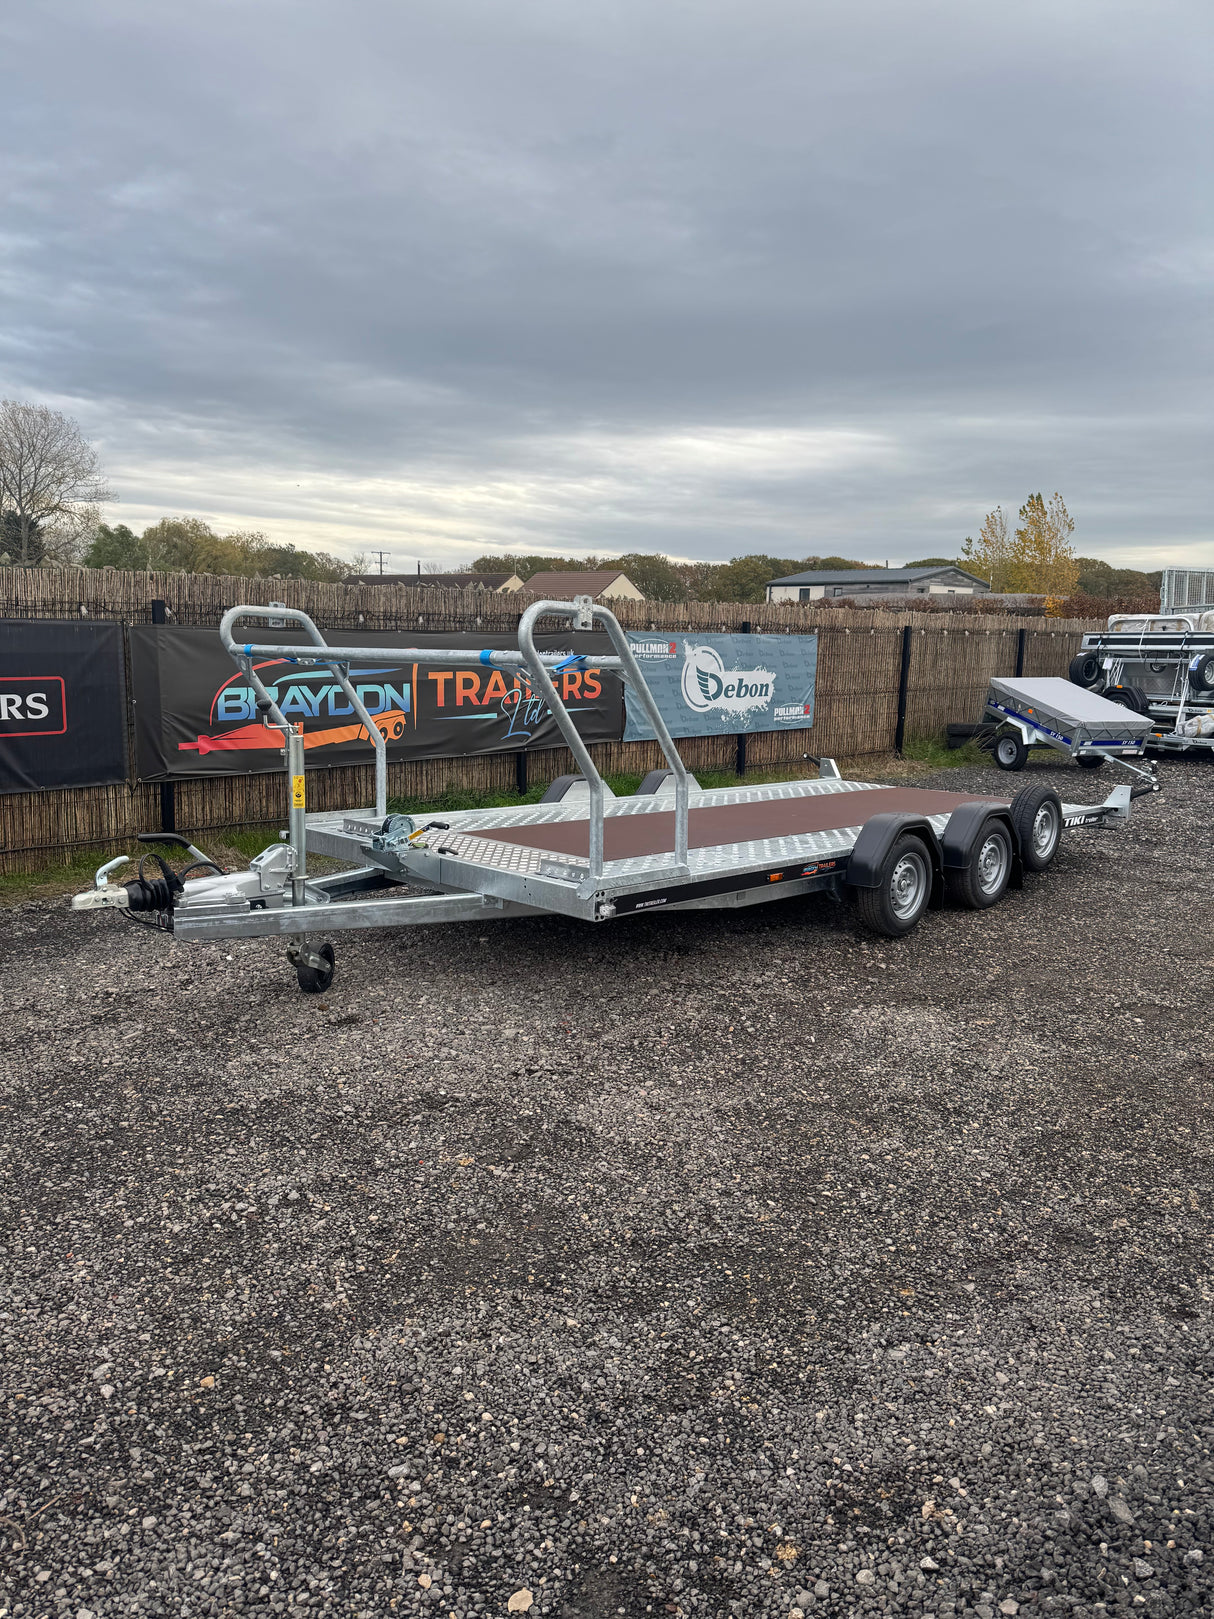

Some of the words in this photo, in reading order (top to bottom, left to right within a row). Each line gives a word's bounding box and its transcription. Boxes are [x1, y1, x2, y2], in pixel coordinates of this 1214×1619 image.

[696, 665, 770, 701] Debon
[217, 683, 411, 721] BRAYDON
[501, 688, 546, 740] Ltd
[1064, 815, 1086, 827] TIKI
